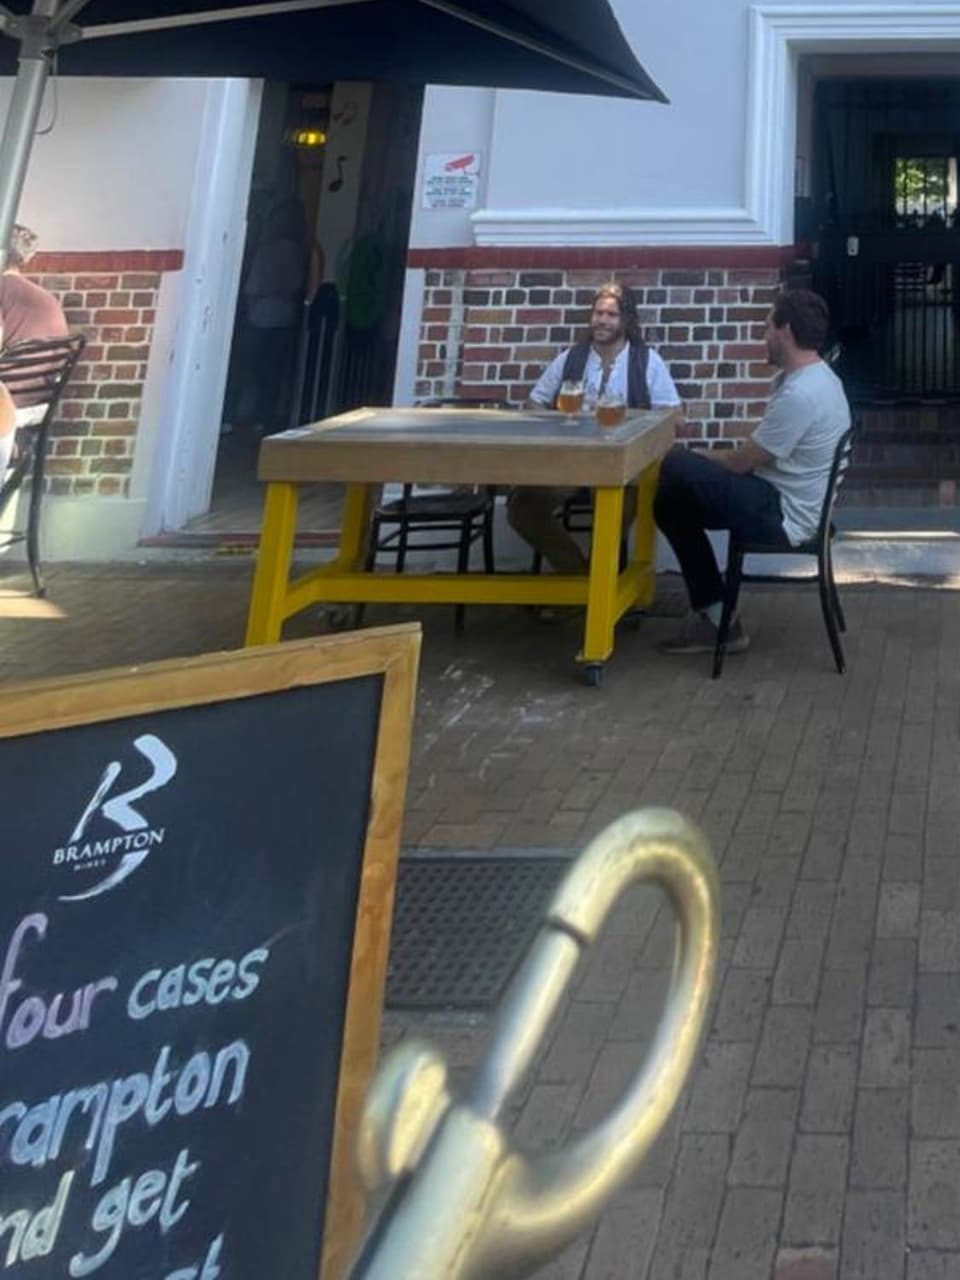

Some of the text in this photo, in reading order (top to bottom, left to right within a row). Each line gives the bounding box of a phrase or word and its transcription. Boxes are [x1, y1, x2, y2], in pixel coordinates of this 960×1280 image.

[53, 827, 165, 865] BRAMPTON
[0, 913, 269, 1049] four cases
[69, 1147, 201, 1278] get
